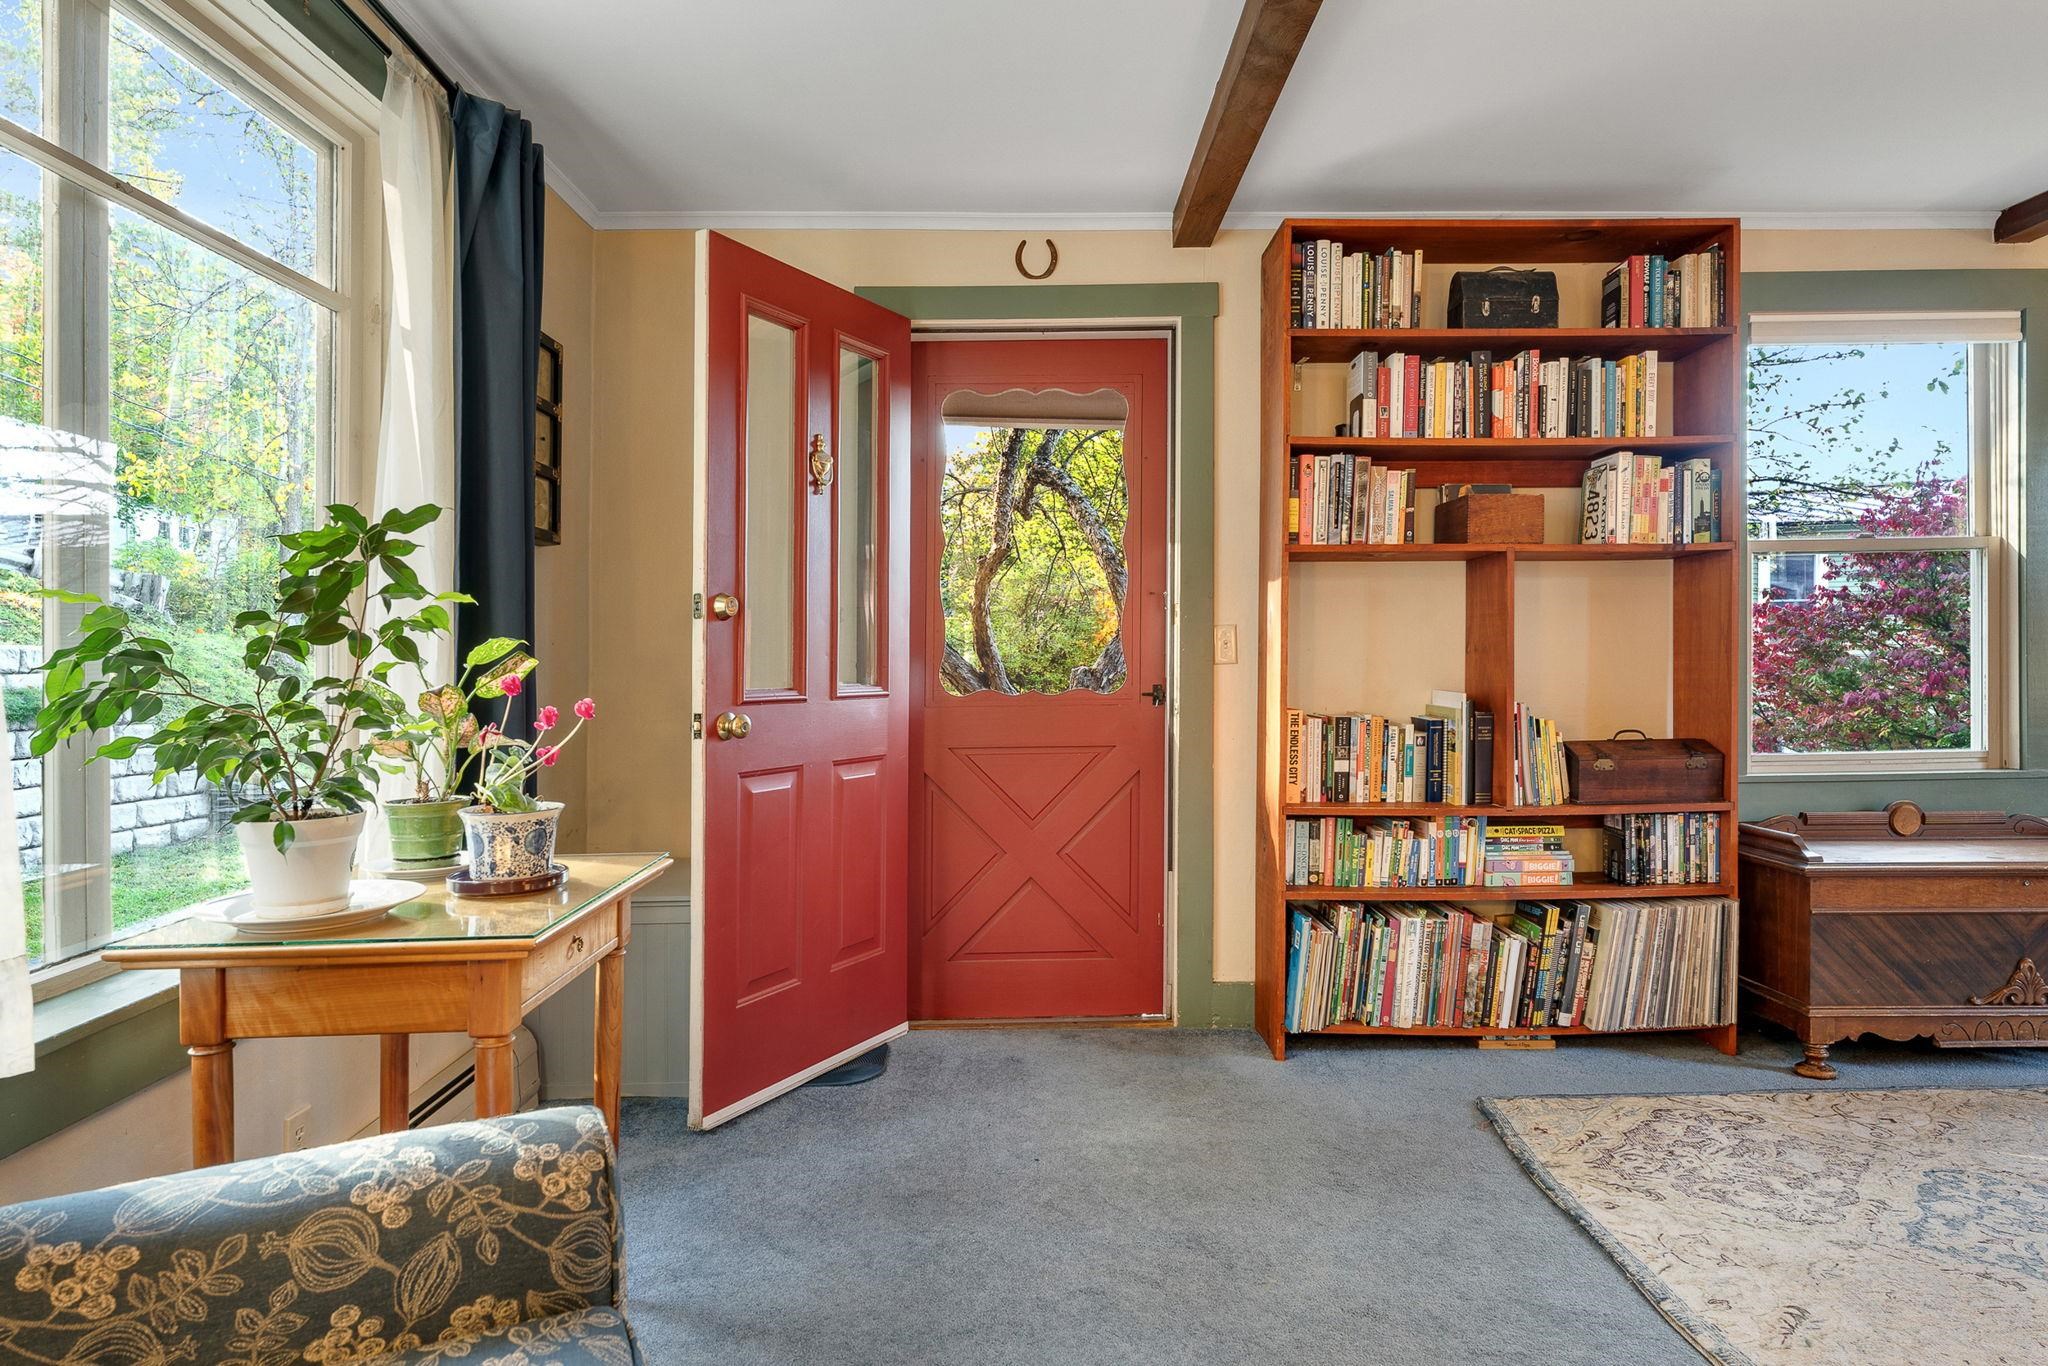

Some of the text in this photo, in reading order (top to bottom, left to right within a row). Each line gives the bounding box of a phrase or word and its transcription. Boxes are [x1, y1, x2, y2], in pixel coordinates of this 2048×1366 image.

[1289, 713, 1300, 785] THE ENDLESS CITY
